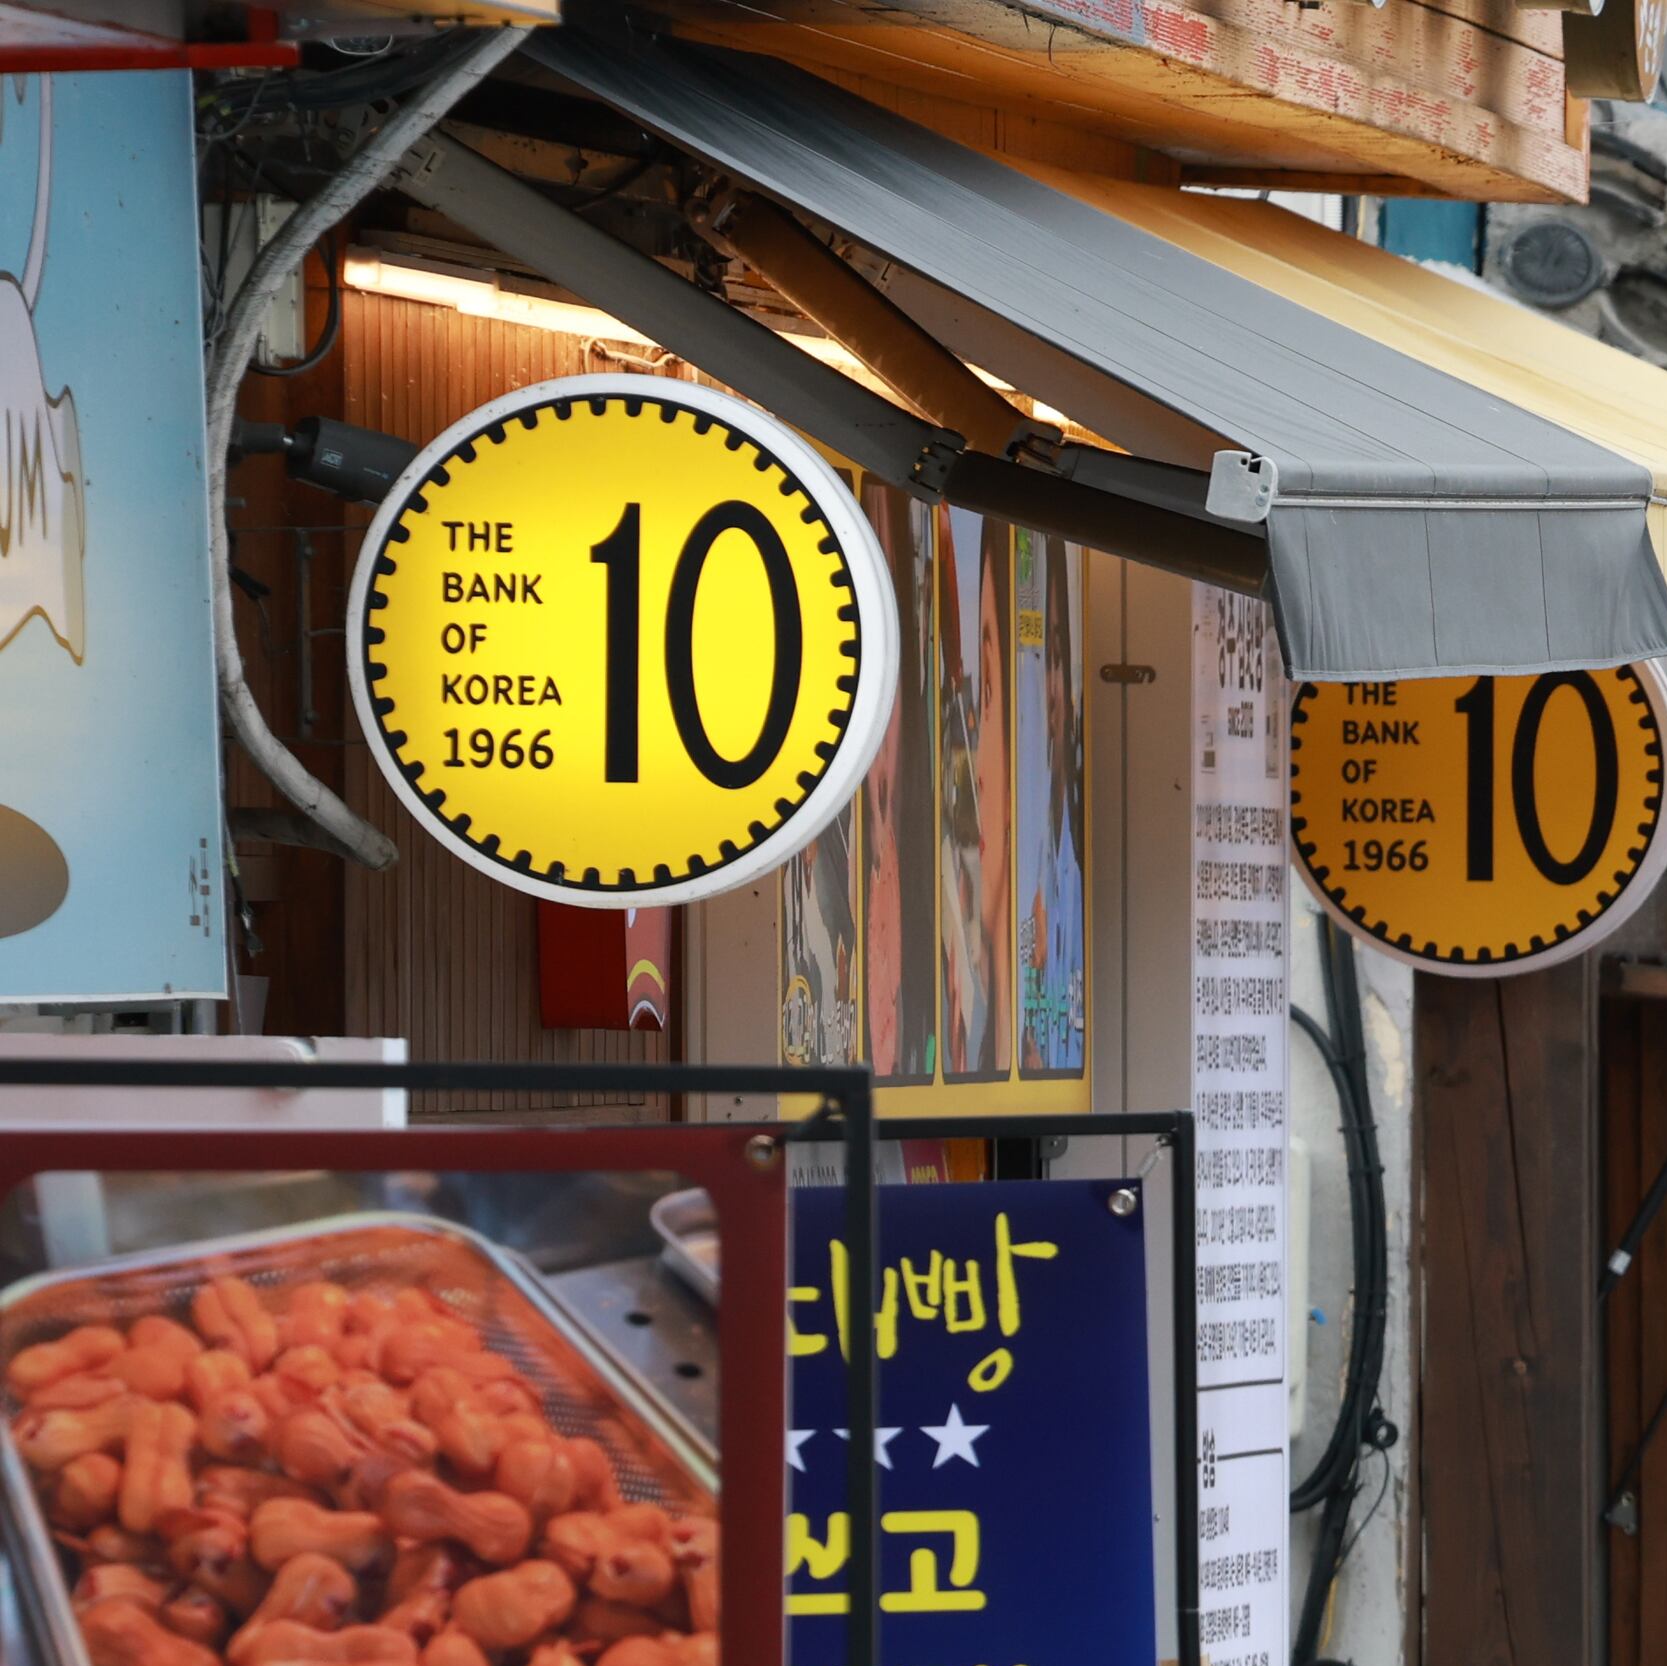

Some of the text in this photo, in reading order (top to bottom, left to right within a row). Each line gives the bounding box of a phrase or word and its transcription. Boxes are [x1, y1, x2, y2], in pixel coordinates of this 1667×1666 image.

[442, 521, 514, 553] THE
[442, 572, 544, 605] BANK
[441, 622, 488, 656] OF
[591, 499, 803, 791] 10
[441, 673, 564, 707] KOREA
[1345, 683, 1398, 707] THE
[442, 728, 556, 770] 1966
[1341, 719, 1420, 747] BANK
[1341, 759, 1378, 785] OF
[1454, 673, 1620, 887] 10
[1341, 798, 1436, 825] KOREA
[1342, 838, 1430, 874] 1966
